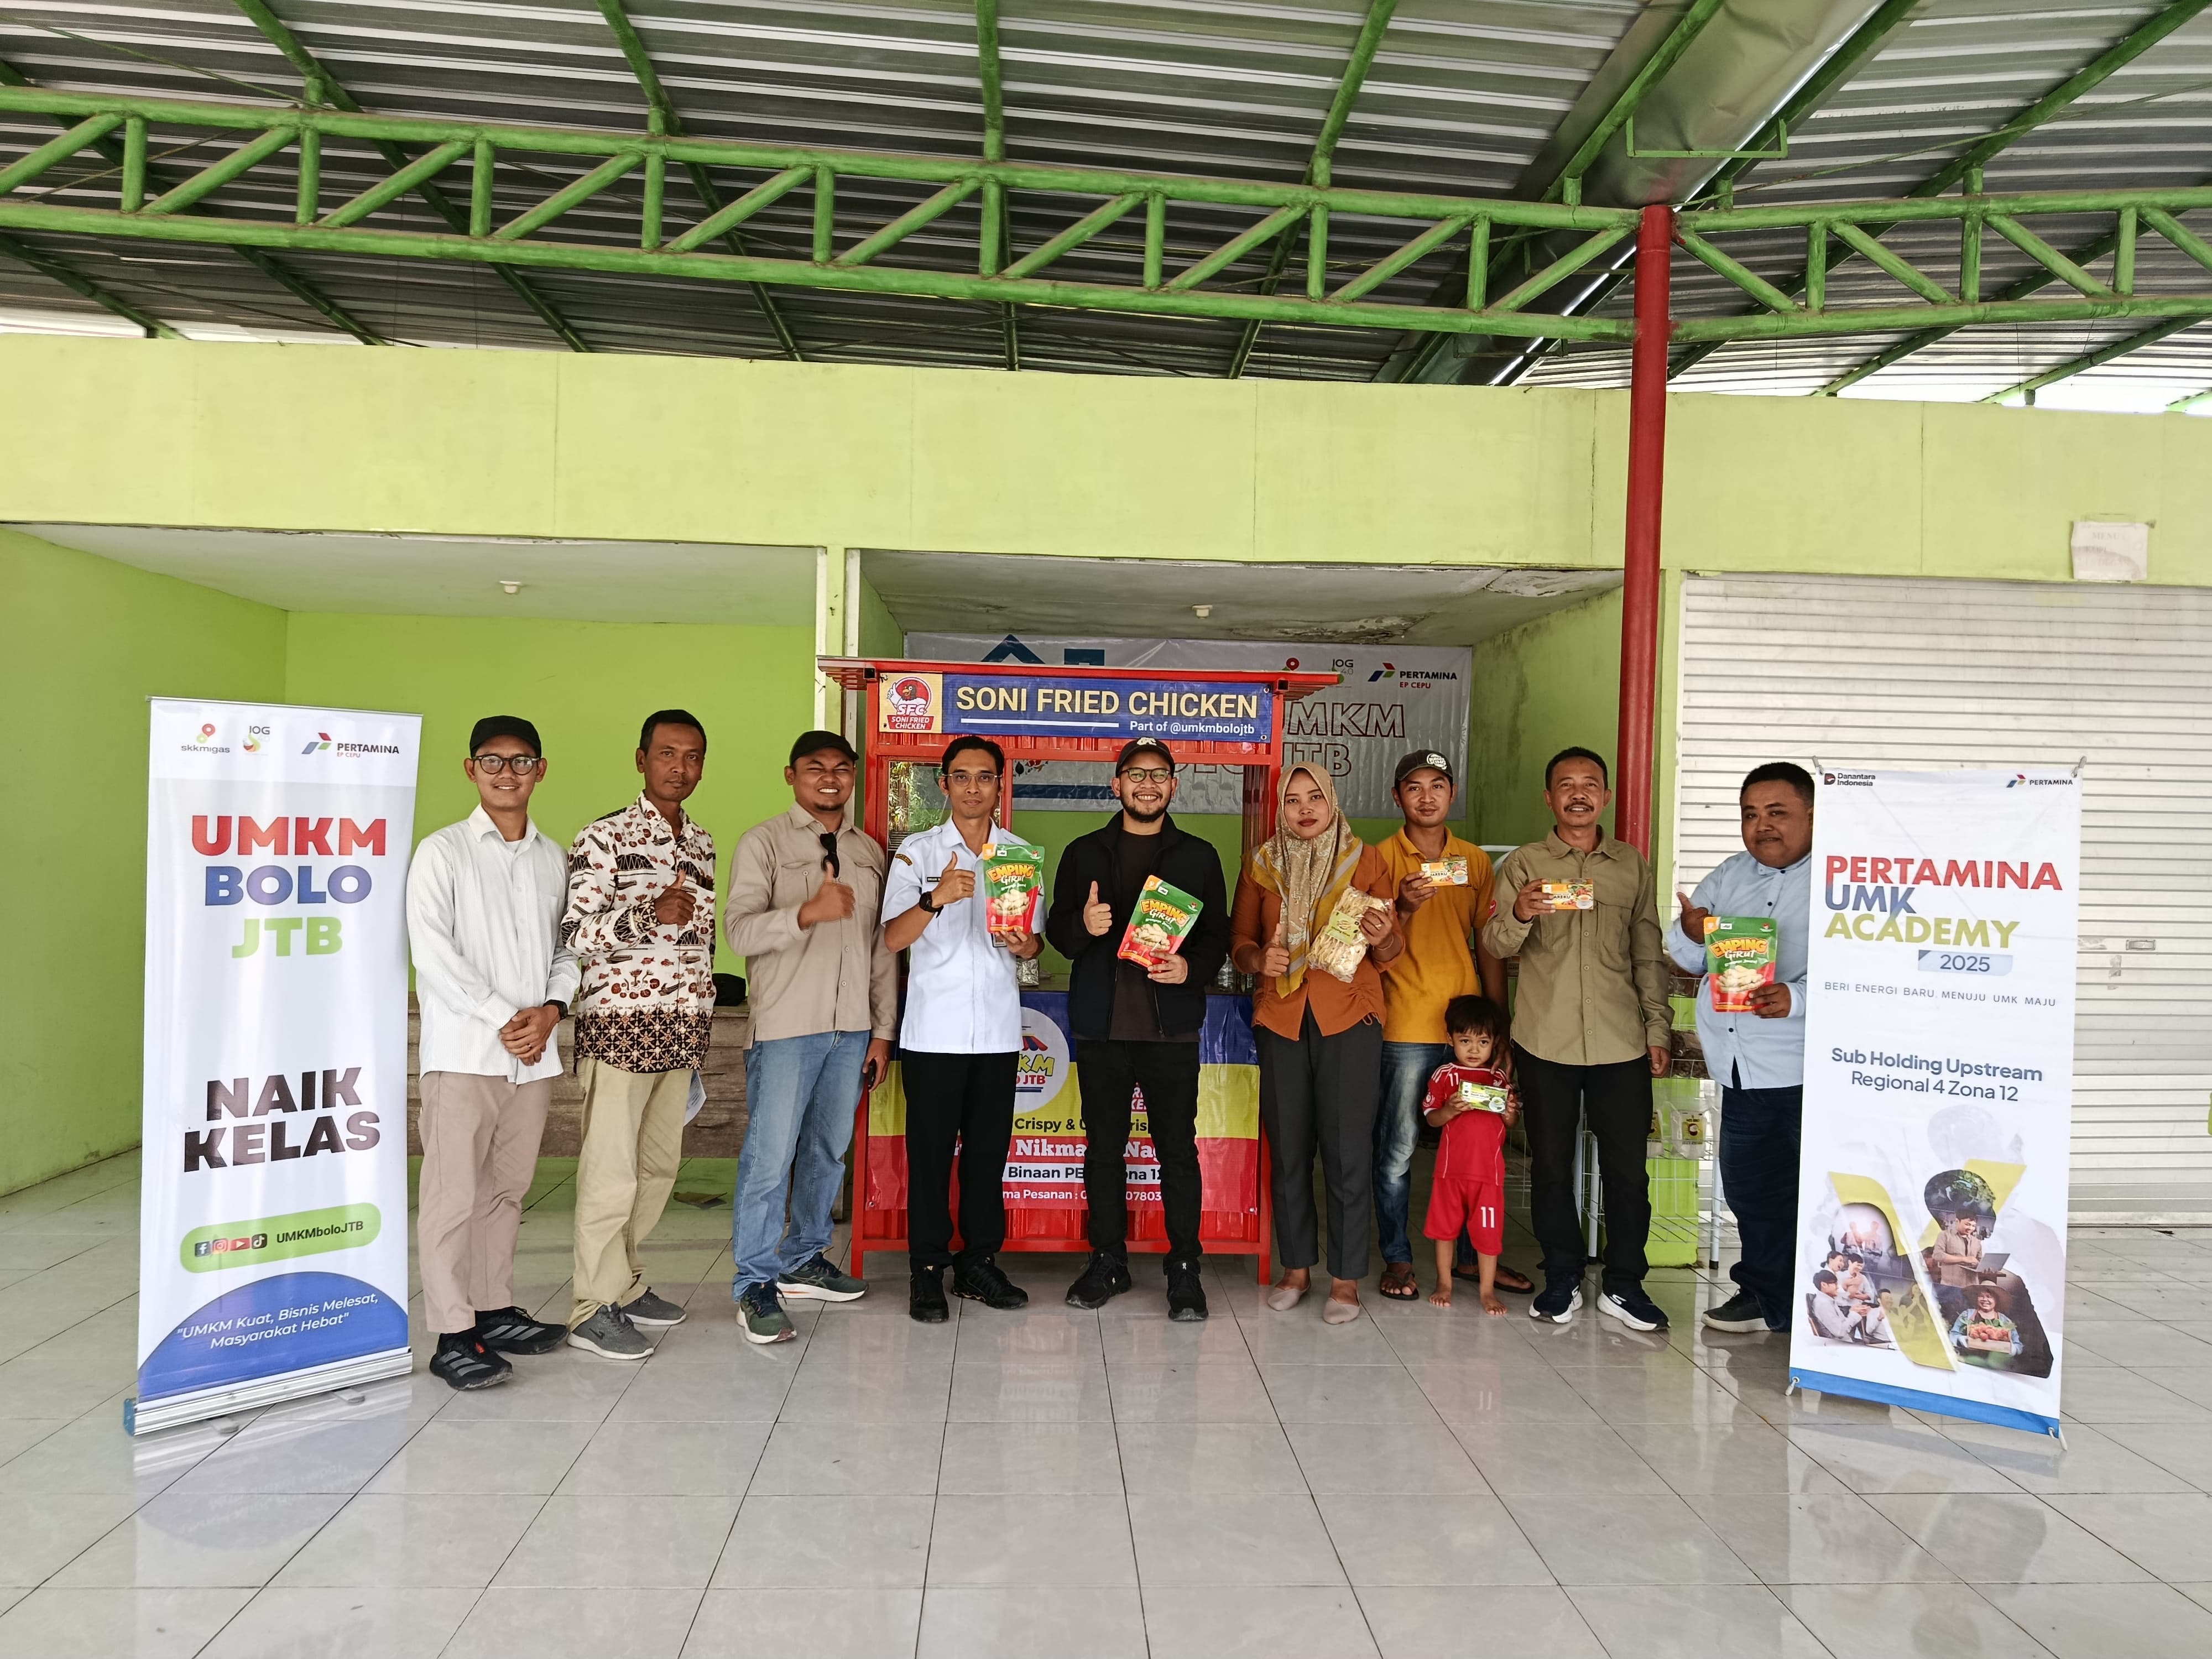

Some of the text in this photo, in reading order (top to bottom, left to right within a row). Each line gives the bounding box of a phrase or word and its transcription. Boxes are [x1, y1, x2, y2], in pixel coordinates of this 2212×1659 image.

[1400, 670, 1458, 680] PERTAMINA
[897, 704, 926, 716] SFC
[956, 686, 1258, 718] SONI FRIED CHICKEN
[1130, 721, 1255, 736] Part of @umkmbolojtb
[1282, 701, 1405, 738] MKM
[181, 744, 230, 754] skkmigas
[337, 743, 399, 754] PERTAMINA
[192, 815, 387, 856] UMKM
[986, 863, 1035, 883] EMPING
[1826, 855, 2063, 890] PERTAMINA
[205, 865, 372, 906] BOLO
[1141, 899, 1188, 926] EMPING
[1825, 885, 1917, 918] UMK
[232, 916, 343, 958] JTB
[1824, 912, 2020, 948] ACADEMY
[1709, 938, 1768, 958] EMPING
[1940, 954, 1990, 972] 2025
[1825, 982, 1850, 992] BERI
[1855, 984, 1897, 995] ENERGI
[1942, 991, 1986, 1001] MENUJU
[1993, 995, 2018, 1004] UMK
[2025, 997, 2056, 1006] MAJU
[1832, 1048, 2043, 1081] Sub Holding Upstream
[1023, 1075, 1045, 1084] JTB
[1449, 1072, 1459, 1087] 11
[1851, 1071, 2018, 1102] Regional 4 Zona 12
[206, 1067, 362, 1121] NAIK
[1014, 1117, 1062, 1133] Crispy
[1066, 1119, 1075, 1130] &
[184, 1111, 380, 1172] KELAS
[1015, 1139, 1087, 1156] Nikma
[1009, 1166, 1060, 1178] Binaan
[1023, 1190, 1072, 1199] Pesanan
[1481, 1206, 1495, 1228] 11
[276, 1220, 363, 1244] UMKMboloJTB
[177, 1291, 379, 1339] "UMKM Kuat, Bisnis Melesat,
[210, 1311, 349, 1349] Masyarakat Hebat"
